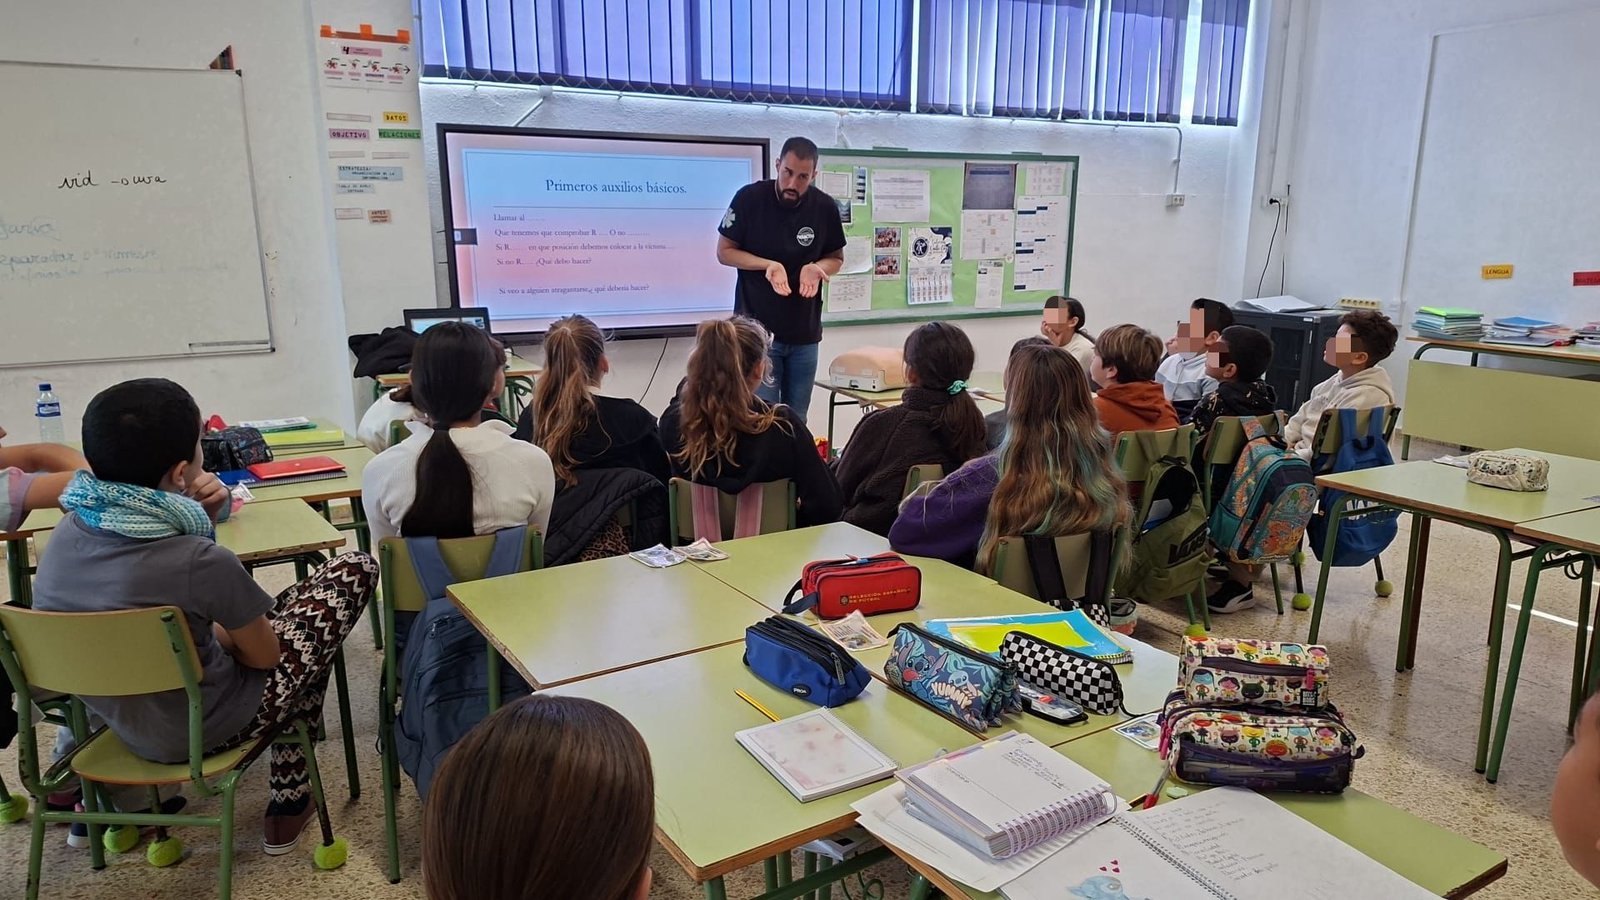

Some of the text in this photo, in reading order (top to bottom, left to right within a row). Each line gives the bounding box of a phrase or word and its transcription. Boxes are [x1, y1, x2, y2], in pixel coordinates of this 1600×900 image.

[385, 114, 407, 122] DATOS
[332, 131, 367, 139] OBJETIVO
[378, 131, 421, 139] RELACIONES
[58, 170, 99, 189] vid
[546, 179, 687, 194] Primeros auxilios básicos.
[494, 213, 517, 221] Llamar
[541, 230, 552, 238] que
[554, 229, 590, 238] comprobar
[495, 243, 503, 251] Si
[538, 245, 549, 253] que
[496, 258, 504, 266] Si
[554, 257, 570, 265] debo
[571, 256, 592, 265] hacer?
[498, 287, 506, 295] Si
[526, 286, 549, 296] alguien
[630, 284, 649, 292] hacer?
[931, 681, 972, 709] YUMMY
